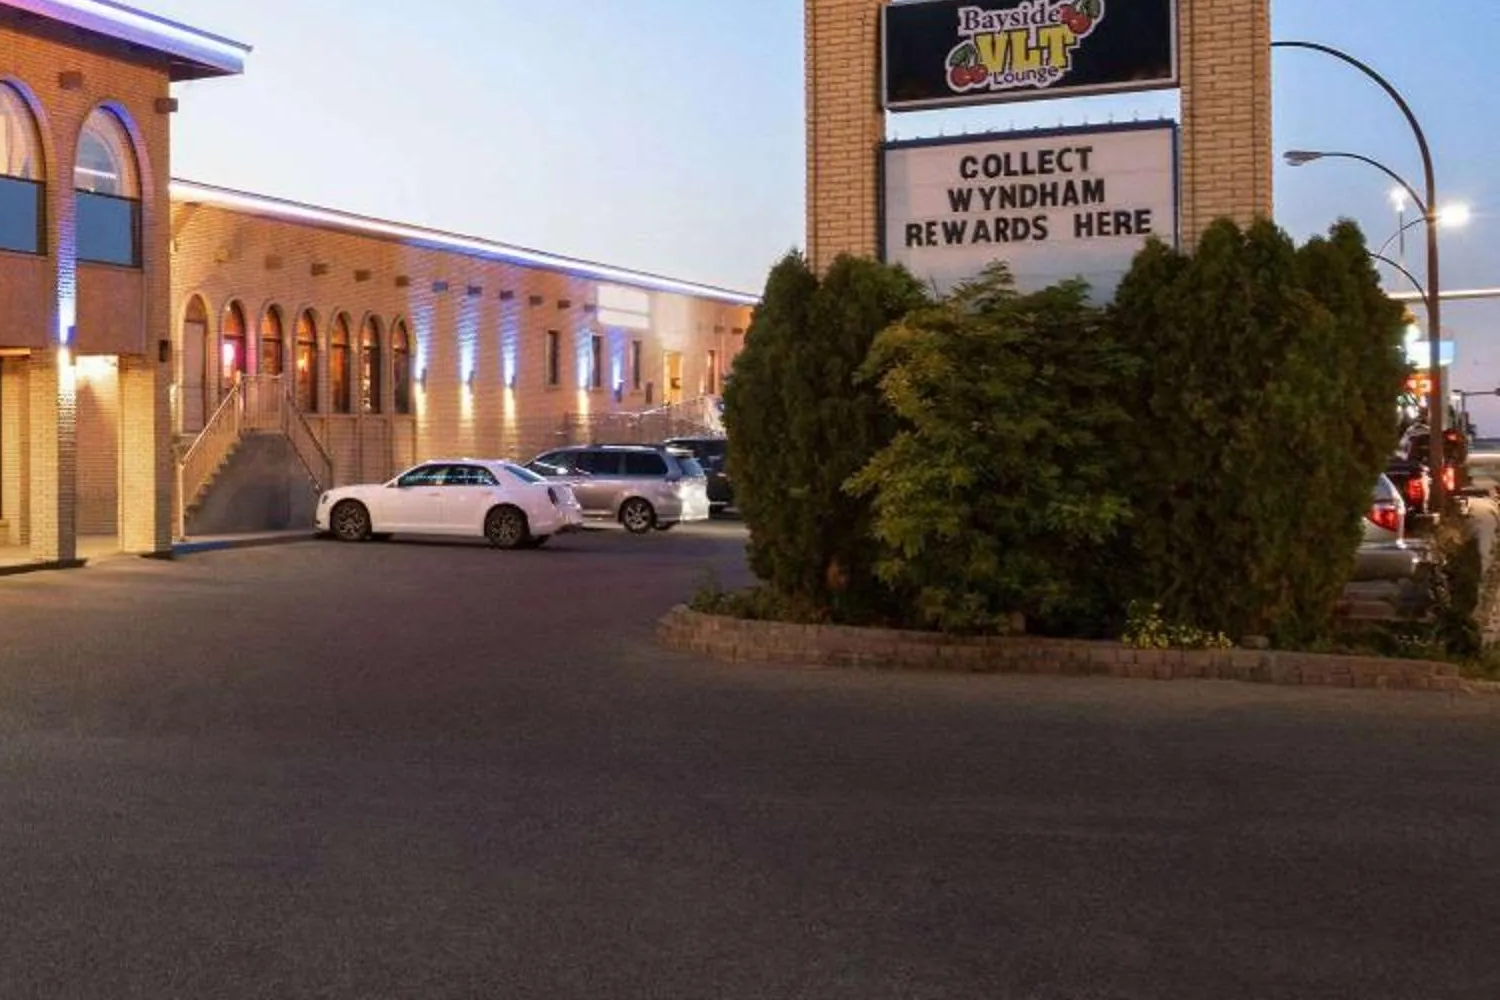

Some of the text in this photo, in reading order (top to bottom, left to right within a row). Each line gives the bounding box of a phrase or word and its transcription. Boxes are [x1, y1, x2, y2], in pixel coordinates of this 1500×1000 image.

[963, 1, 1061, 31] Bayside
[974, 23, 1076, 75] VLT
[993, 65, 1059, 85] Lounge
[959, 146, 1093, 181] COLLECT
[947, 178, 1106, 213] WYNDHAM
[904, 208, 1153, 248] REWARDS HERE
